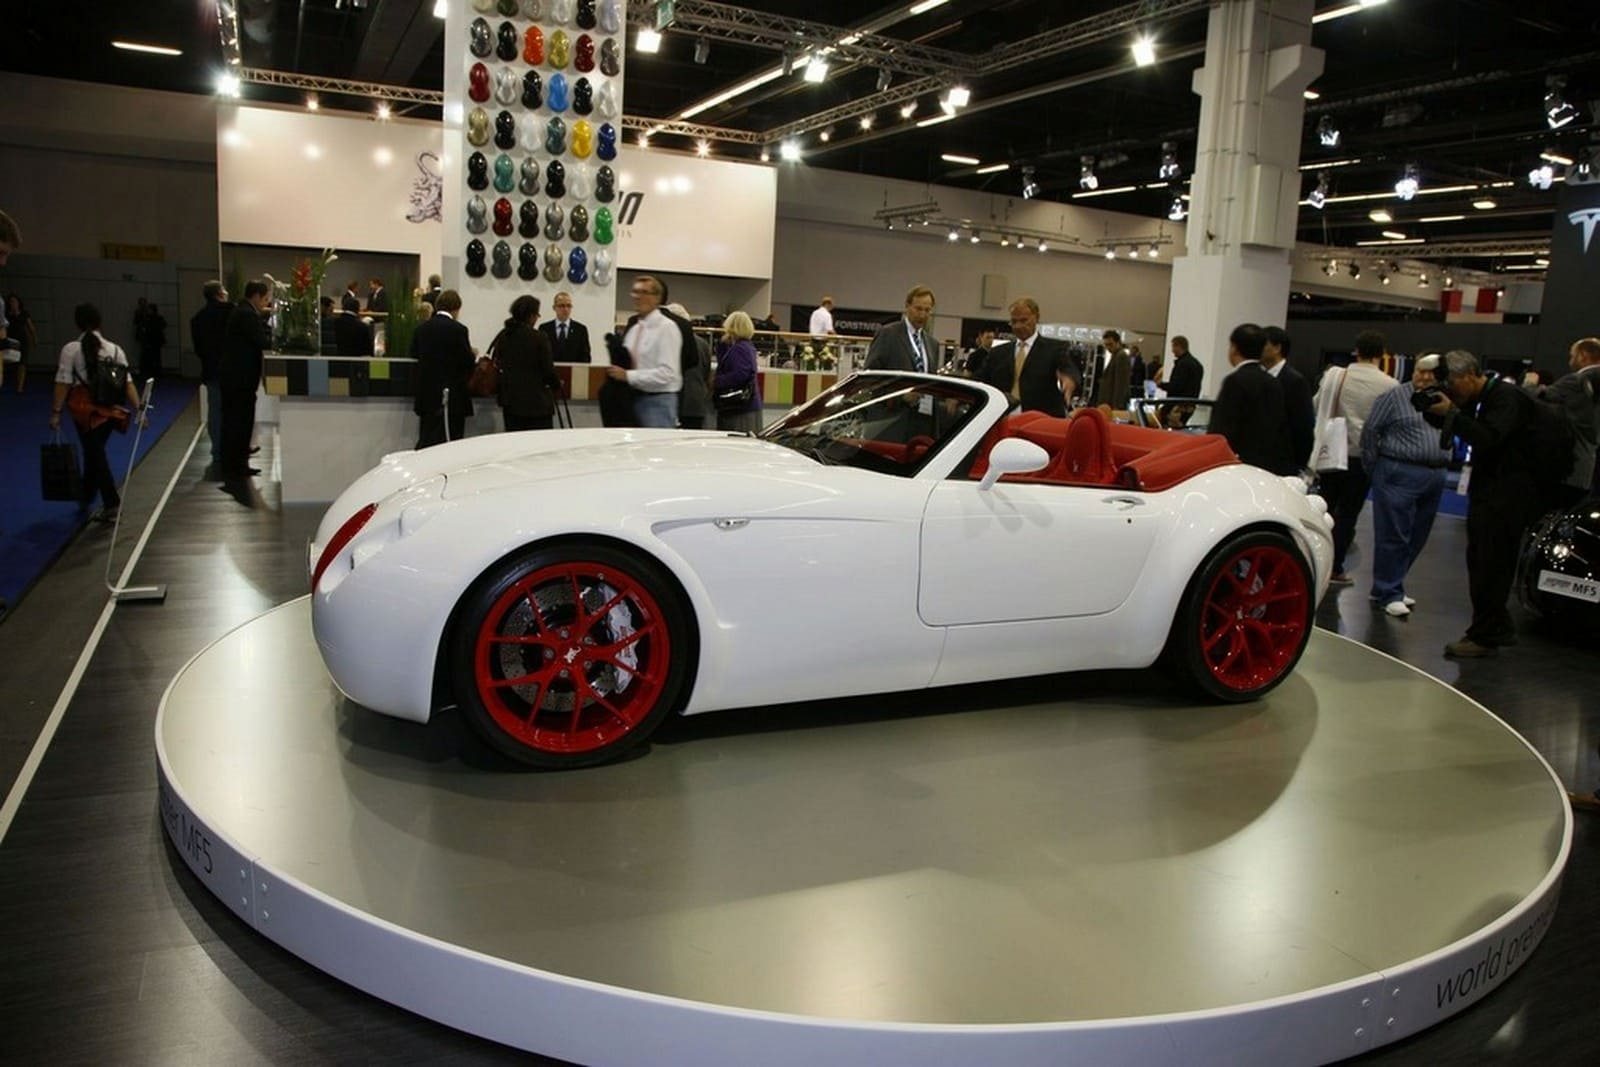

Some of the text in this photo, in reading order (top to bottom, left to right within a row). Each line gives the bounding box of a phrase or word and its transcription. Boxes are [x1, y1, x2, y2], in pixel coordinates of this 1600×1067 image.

[1572, 583, 1597, 596] MF5
[181, 813, 213, 873] MF5
[1437, 938, 1505, 1009] world
